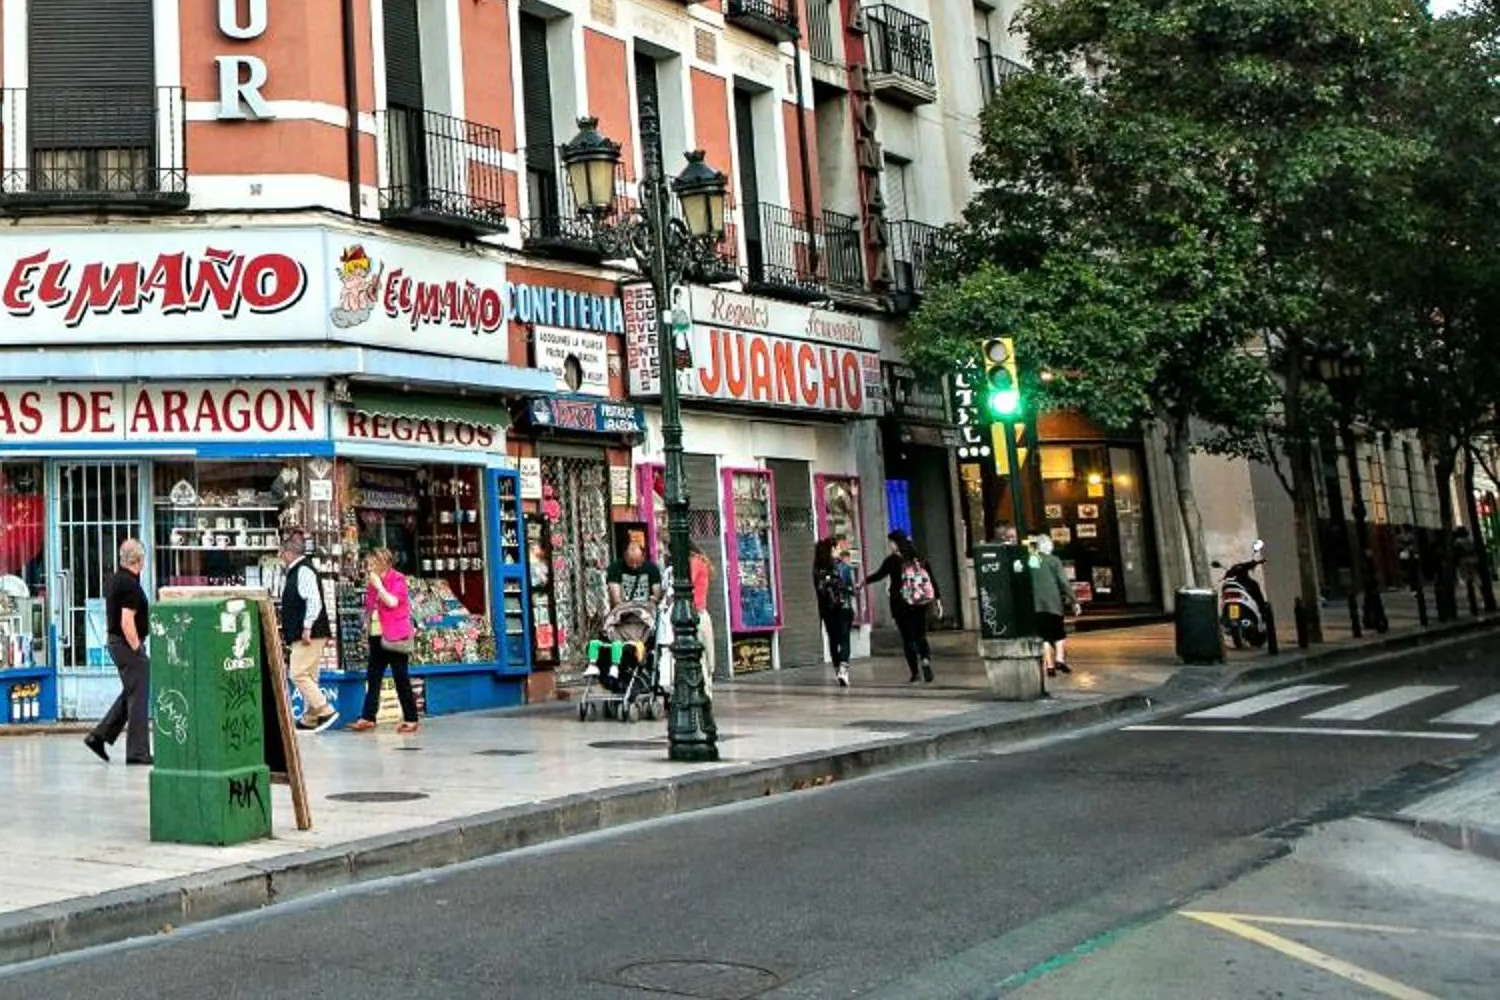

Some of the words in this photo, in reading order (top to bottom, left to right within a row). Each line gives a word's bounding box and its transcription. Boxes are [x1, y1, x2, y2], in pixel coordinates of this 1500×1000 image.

[504, 281, 625, 335] CONFITERIA
[697, 328, 864, 411] JUANCHO
[58, 390, 116, 433] DE
[129, 388, 316, 433] ARAGON
[346, 410, 494, 447] REGALOS
